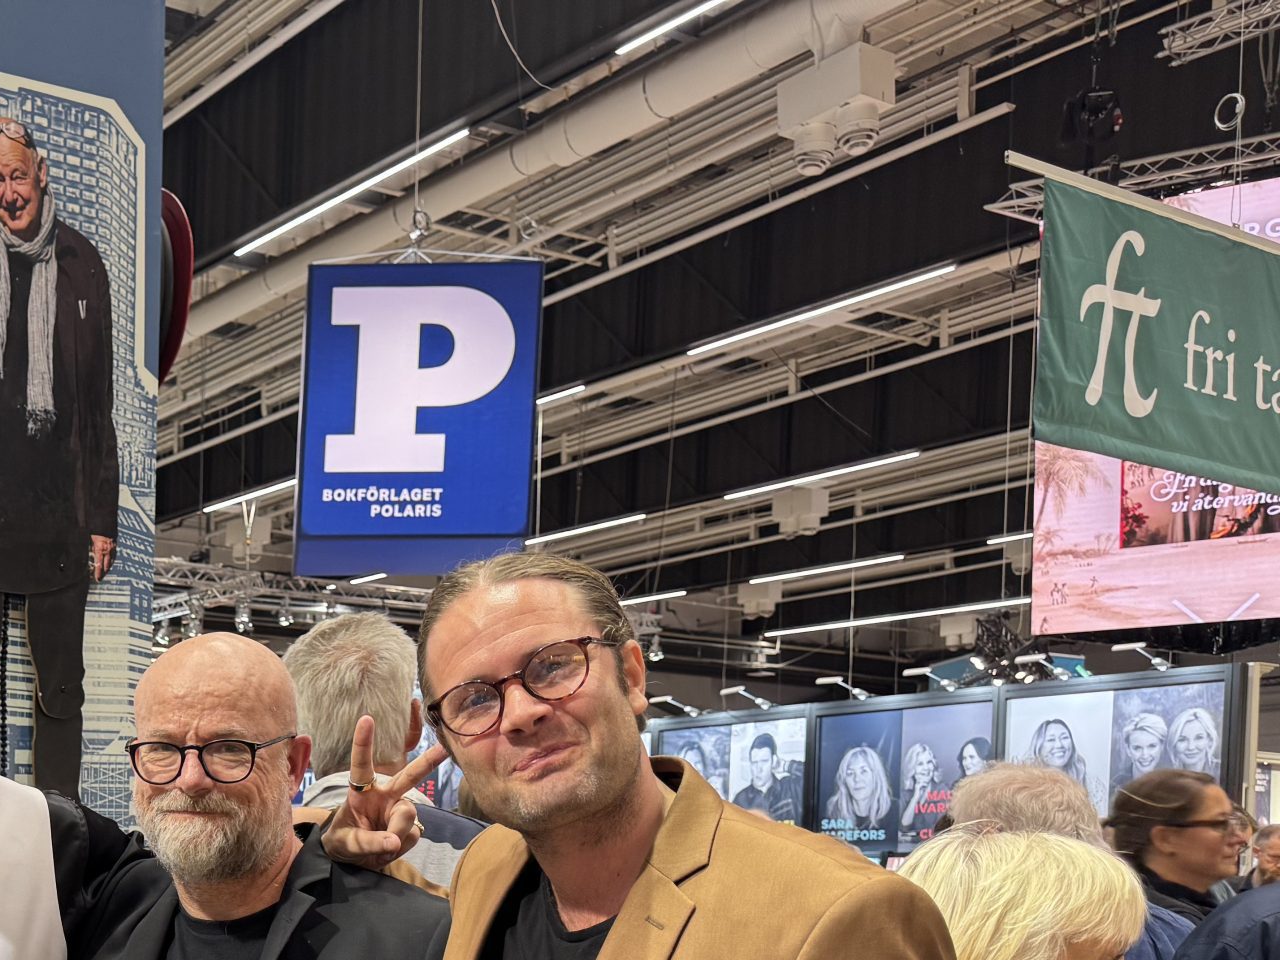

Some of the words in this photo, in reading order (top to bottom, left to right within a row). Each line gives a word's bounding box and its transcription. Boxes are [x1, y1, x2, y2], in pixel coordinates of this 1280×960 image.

[1184, 310, 1238, 402] fri
[323, 285, 516, 473] P
[322, 486, 443, 502] BOKFÖRLAGET
[370, 504, 442, 518] POLARIS
[1172, 495, 1191, 513] vi
[914, 802, 949, 814] IVAR
[821, 818, 854, 830] SARA
